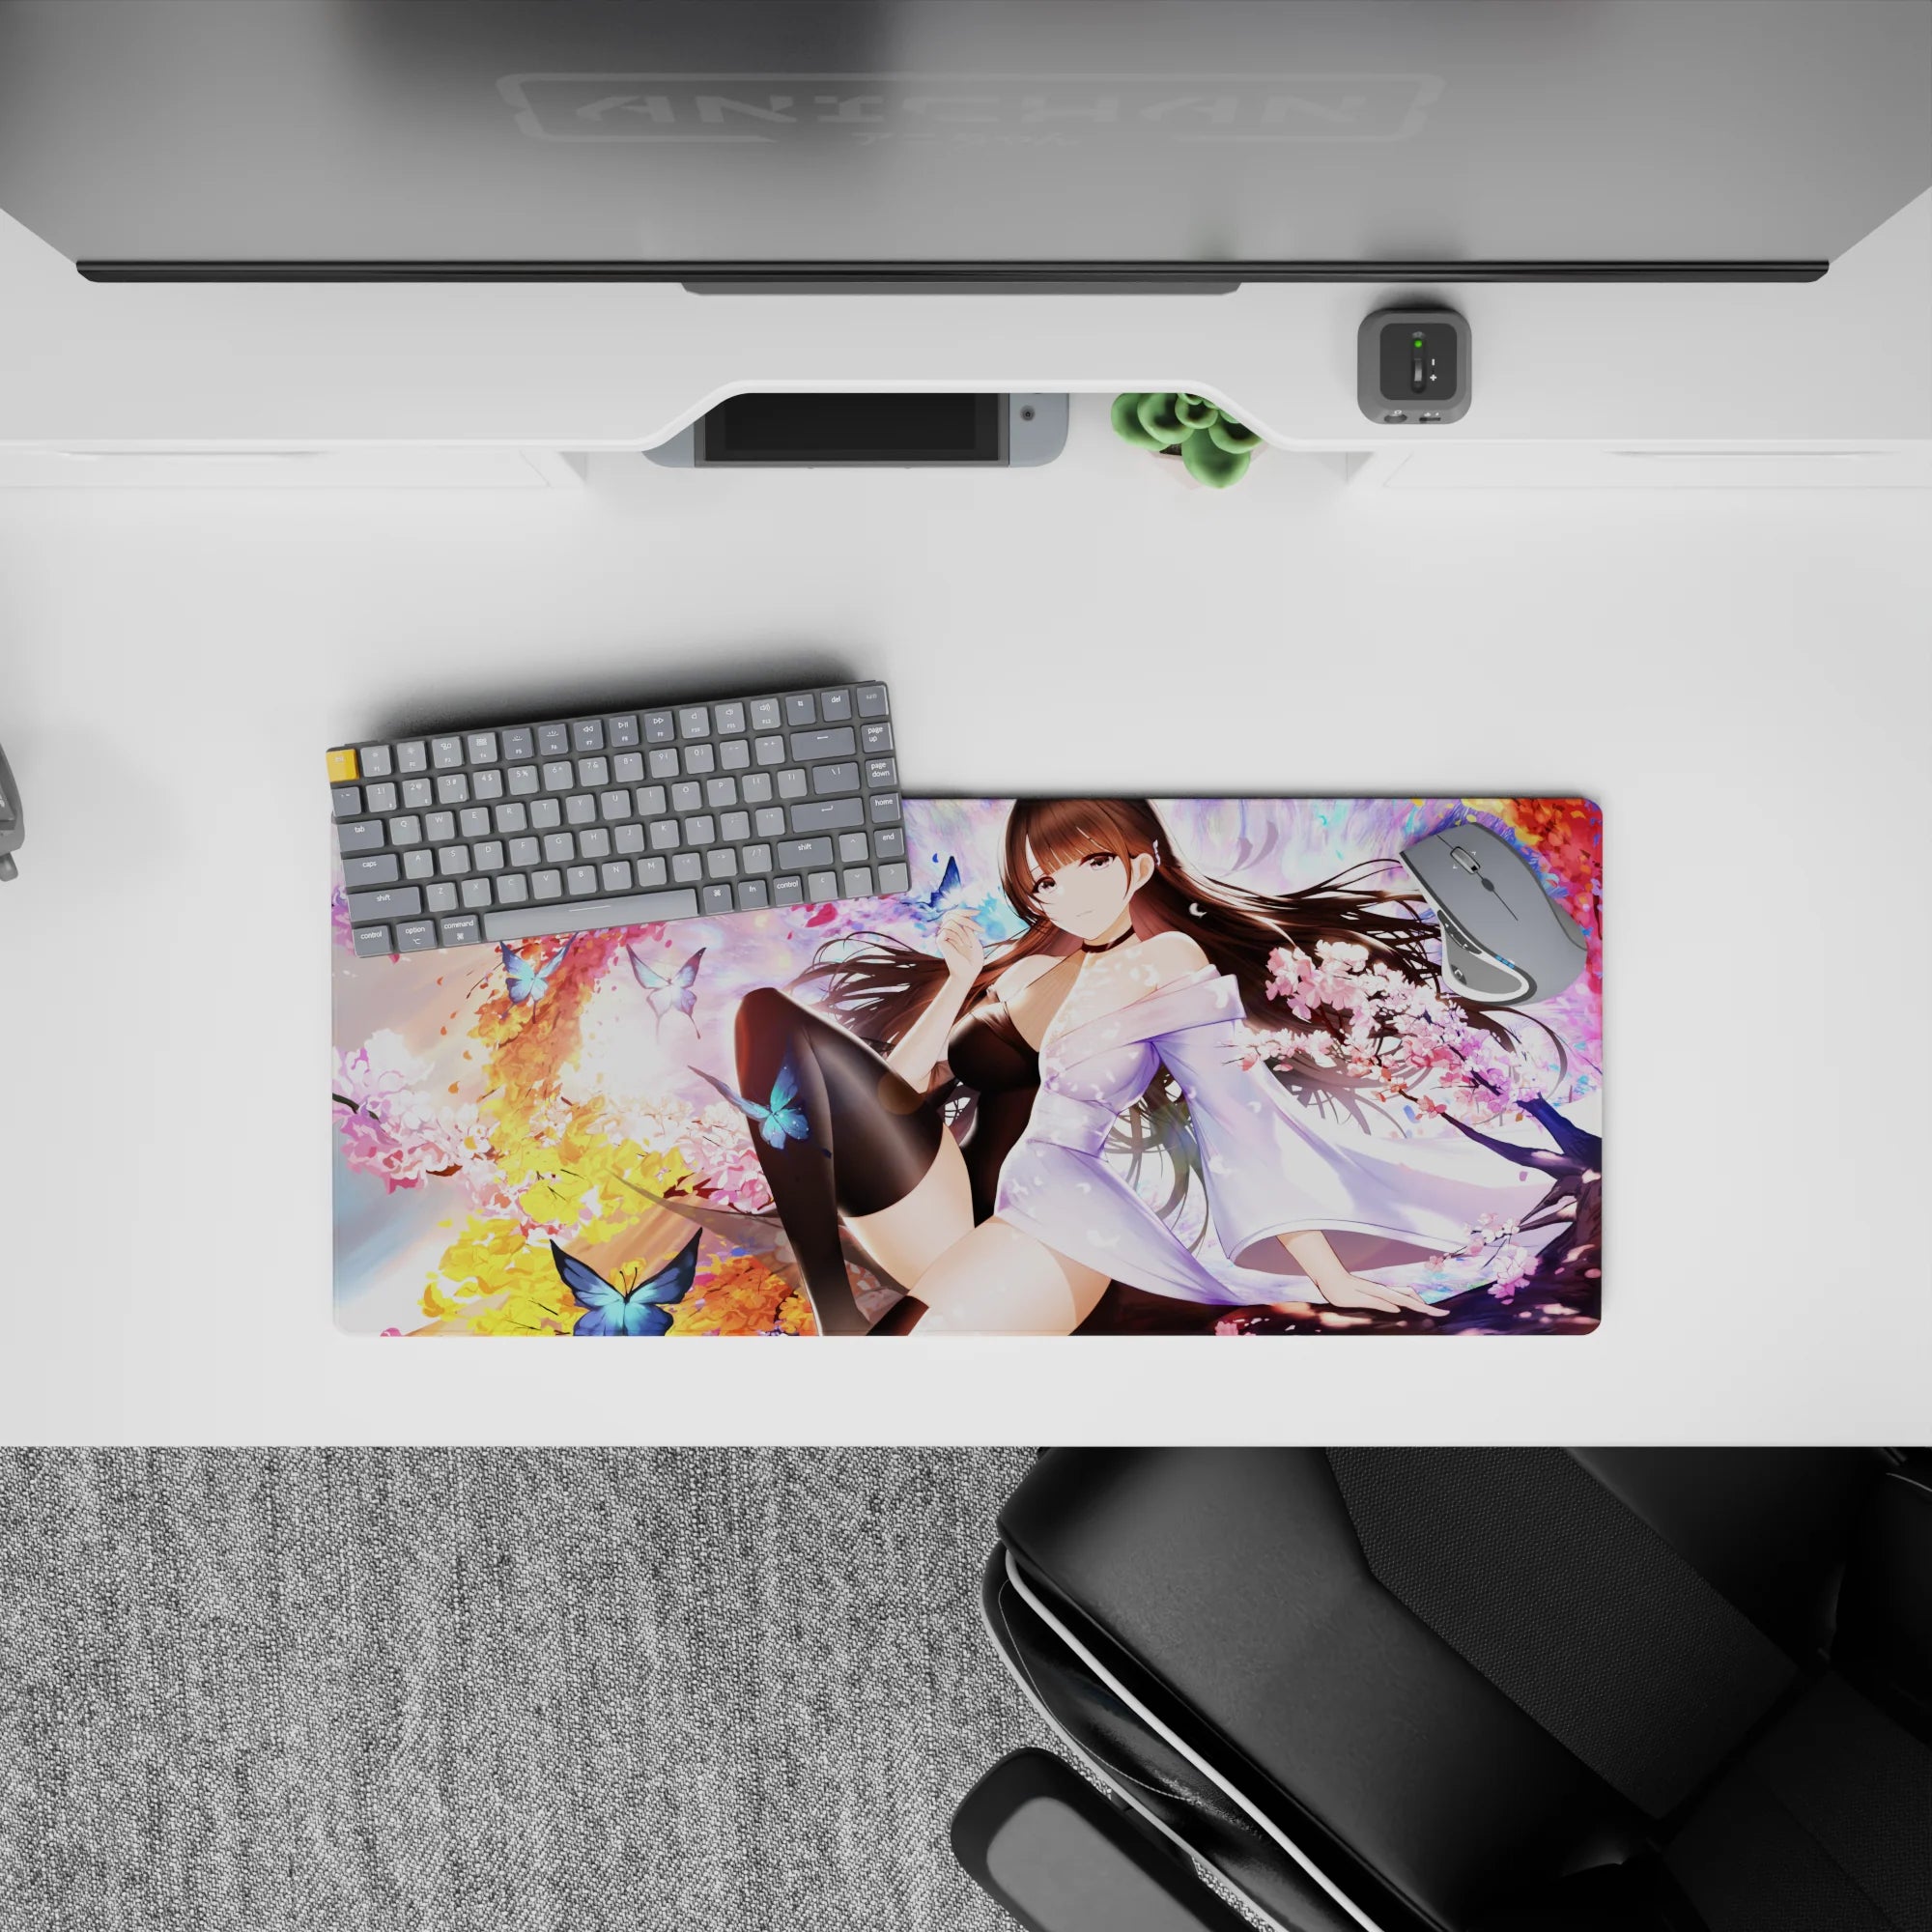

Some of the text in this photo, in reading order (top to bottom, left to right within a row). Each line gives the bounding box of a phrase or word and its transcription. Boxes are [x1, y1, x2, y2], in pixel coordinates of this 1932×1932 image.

[576, 96, 1368, 123] ANICHAN
[831, 695, 841, 703] del
[867, 726, 884, 735] page
[354, 825, 365, 834] tab
[882, 832, 895, 841] end
[797, 842, 812, 851] shift
[777, 880, 800, 889] control
[376, 894, 391, 902] shift
[443, 919, 474, 929] command
[359, 930, 383, 940] control
[405, 926, 426, 935] option
